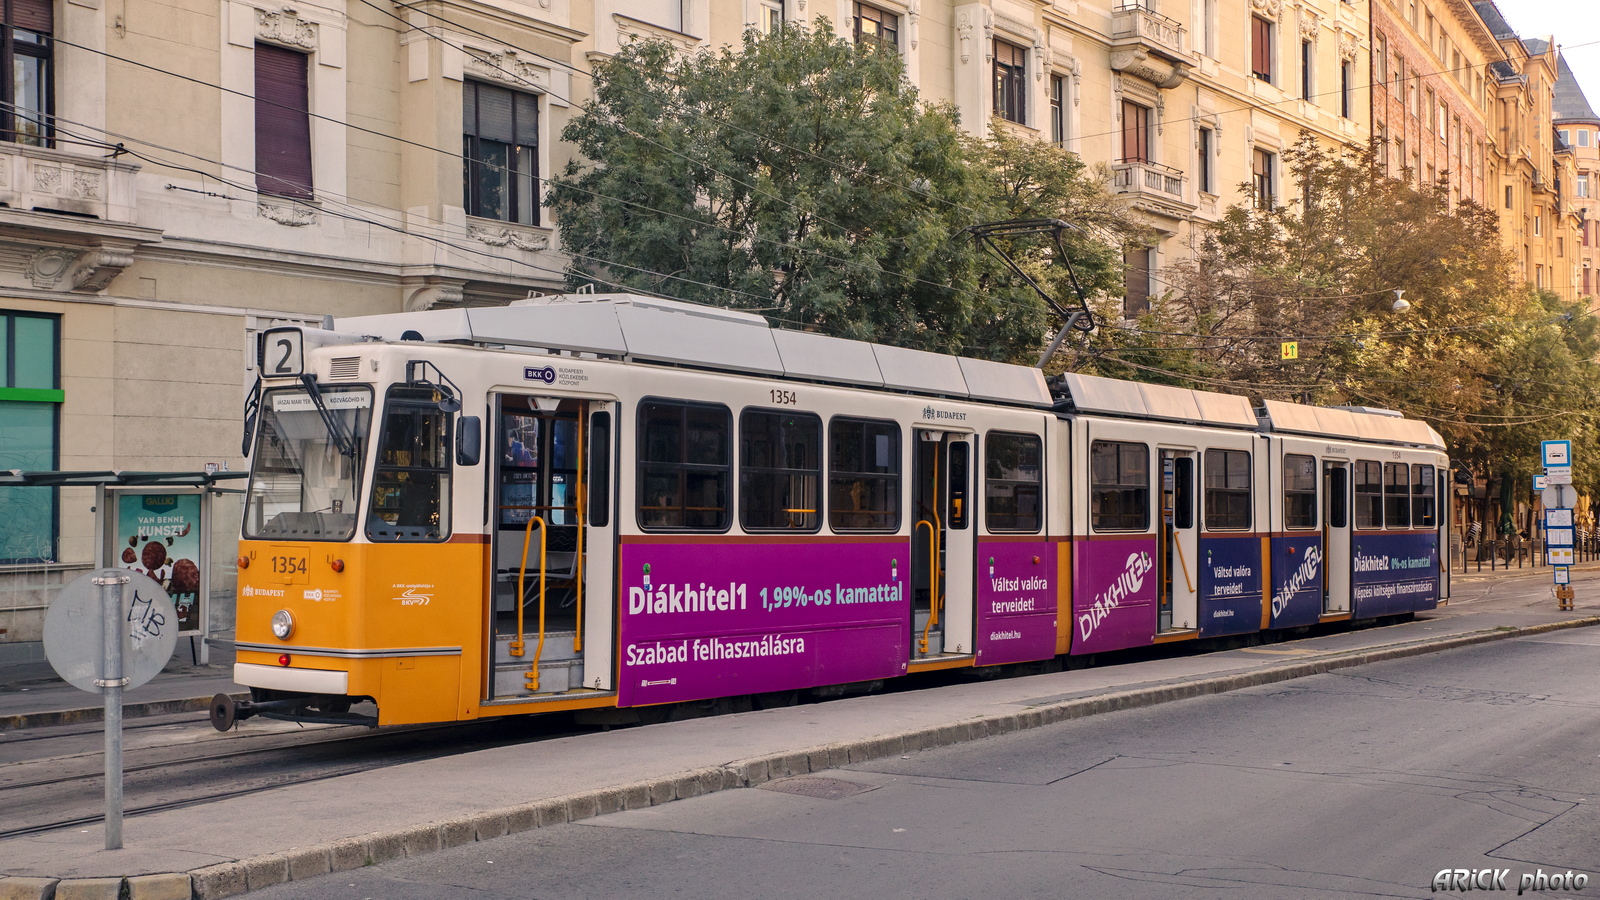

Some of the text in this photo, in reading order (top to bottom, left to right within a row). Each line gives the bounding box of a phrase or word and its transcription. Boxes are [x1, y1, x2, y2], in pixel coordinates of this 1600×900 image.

[275, 338, 293, 374] 2
[527, 370, 543, 378] BKK
[558, 367, 584, 375] BUDAPESTI
[558, 373, 589, 381] KÖZLEKEDÉSI
[769, 388, 797, 405] 1354
[936, 410, 967, 421] BUDAPEST
[1392, 451, 1402, 460] 1354
[146, 496, 175, 506] GALLIO
[138, 516, 184, 524] VAN BENNE
[137, 525, 186, 537] KUNSZT
[271, 556, 307, 575] 1354
[1354, 555, 1389, 572] Diákhitel2
[1408, 555, 1431, 569] kamattal
[1213, 565, 1251, 579] Váltsd valóra
[992, 576, 1048, 592] Váltsd valóra
[1214, 583, 1243, 595] terveidet!
[255, 588, 285, 597] BUDAPEST
[629, 581, 903, 615] Diákhitel1 1,99%-os kamattal
[992, 598, 1035, 613] terveidet!
[990, 631, 1021, 641] diakhitel.hu
[626, 635, 805, 666] Szabad felhasználásra
